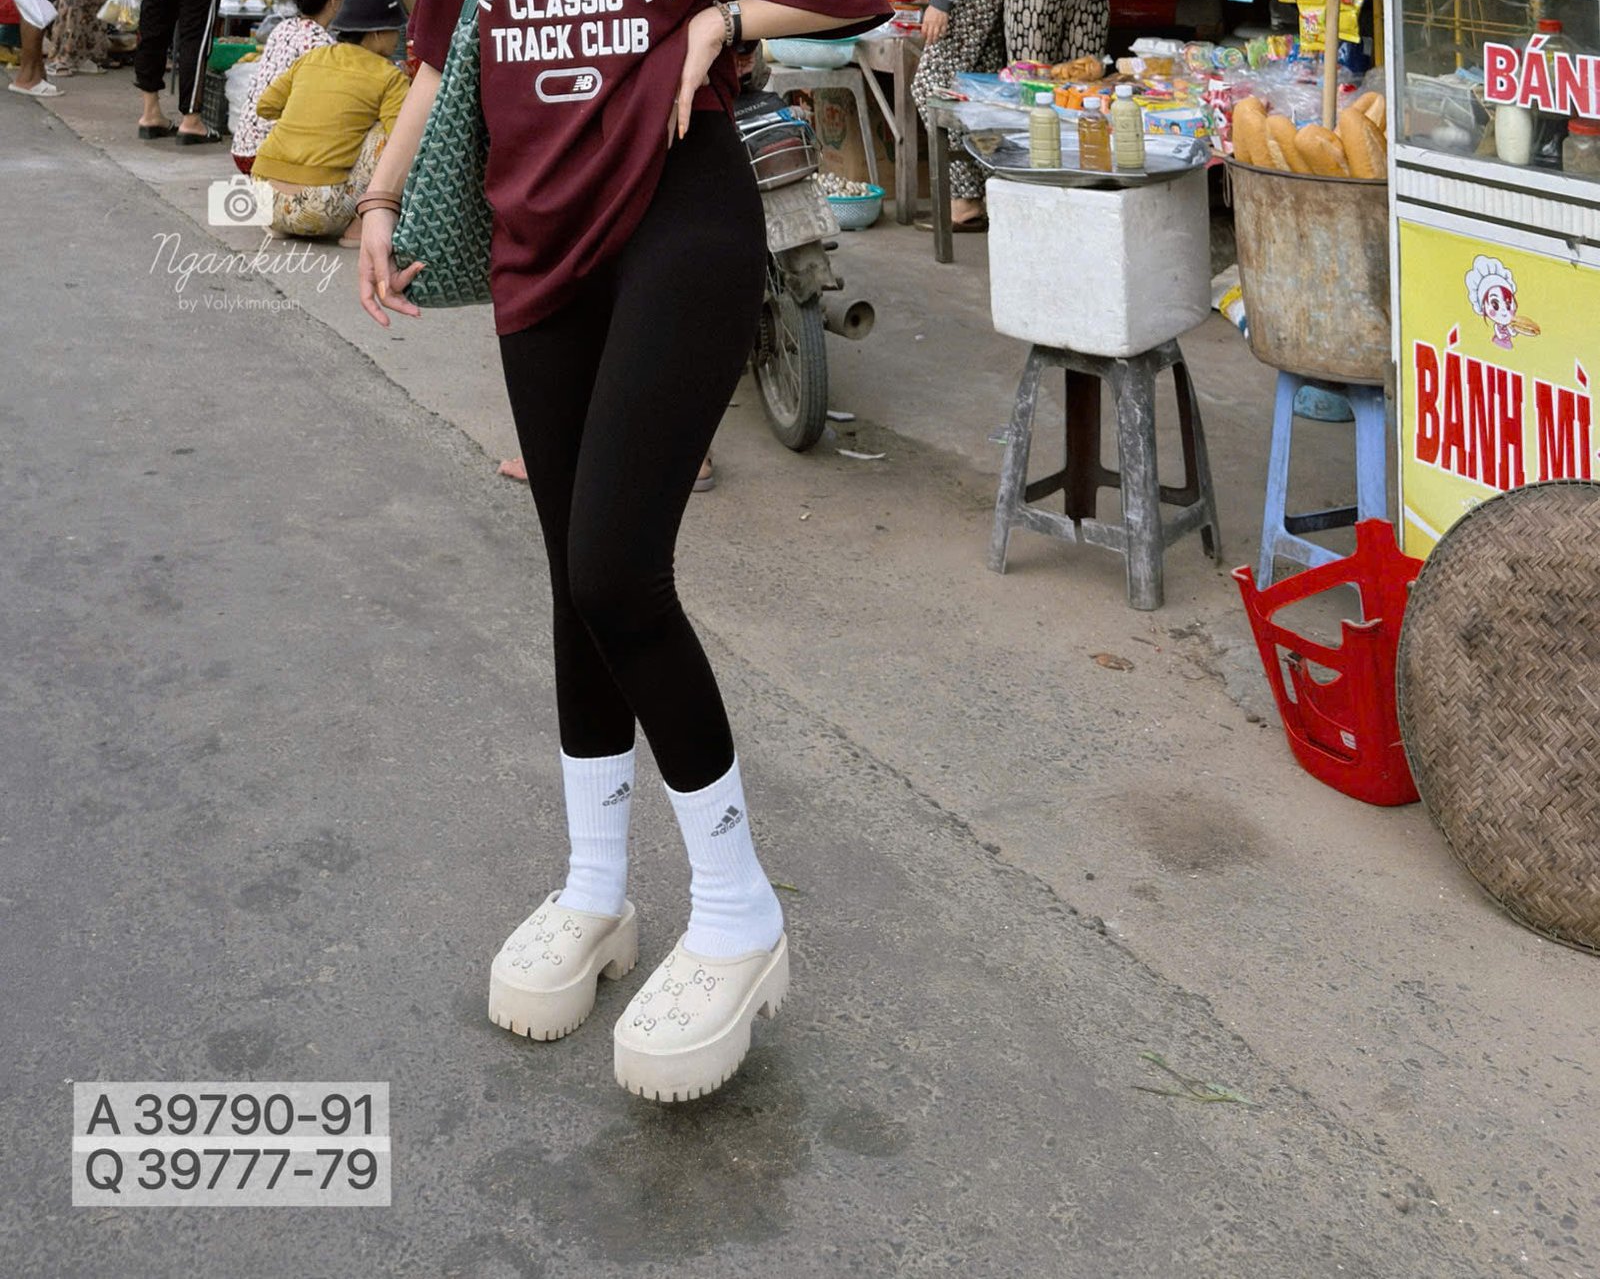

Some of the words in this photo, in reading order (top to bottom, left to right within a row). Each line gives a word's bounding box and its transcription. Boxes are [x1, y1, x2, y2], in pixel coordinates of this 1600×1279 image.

[491, 25, 574, 63] TRACK
[580, 18, 650, 57] CLUB
[1484, 33, 1600, 119] BÁN
[734, 101, 768, 117] ONDA
[1414, 325, 1525, 491] BÁNH
[1533, 358, 1592, 482] MÌ
